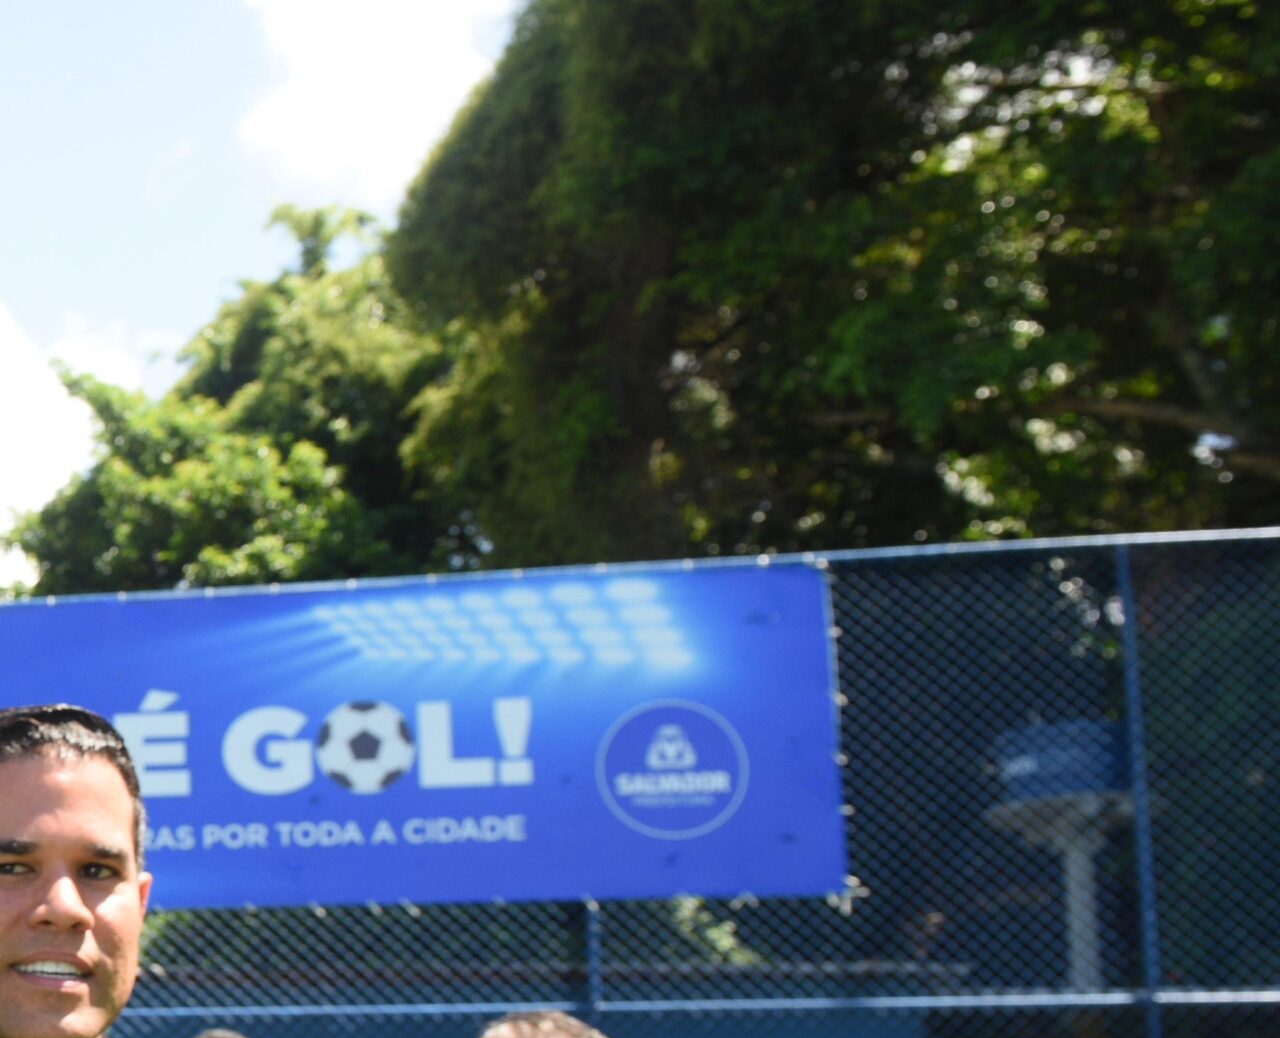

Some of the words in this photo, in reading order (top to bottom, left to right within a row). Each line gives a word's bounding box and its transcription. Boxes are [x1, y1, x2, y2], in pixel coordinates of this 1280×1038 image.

[113, 690, 191, 798] É
[203, 821, 268, 850] POR
[274, 819, 365, 848] TODA
[370, 818, 397, 846] A
[402, 813, 527, 844] CIDADE
